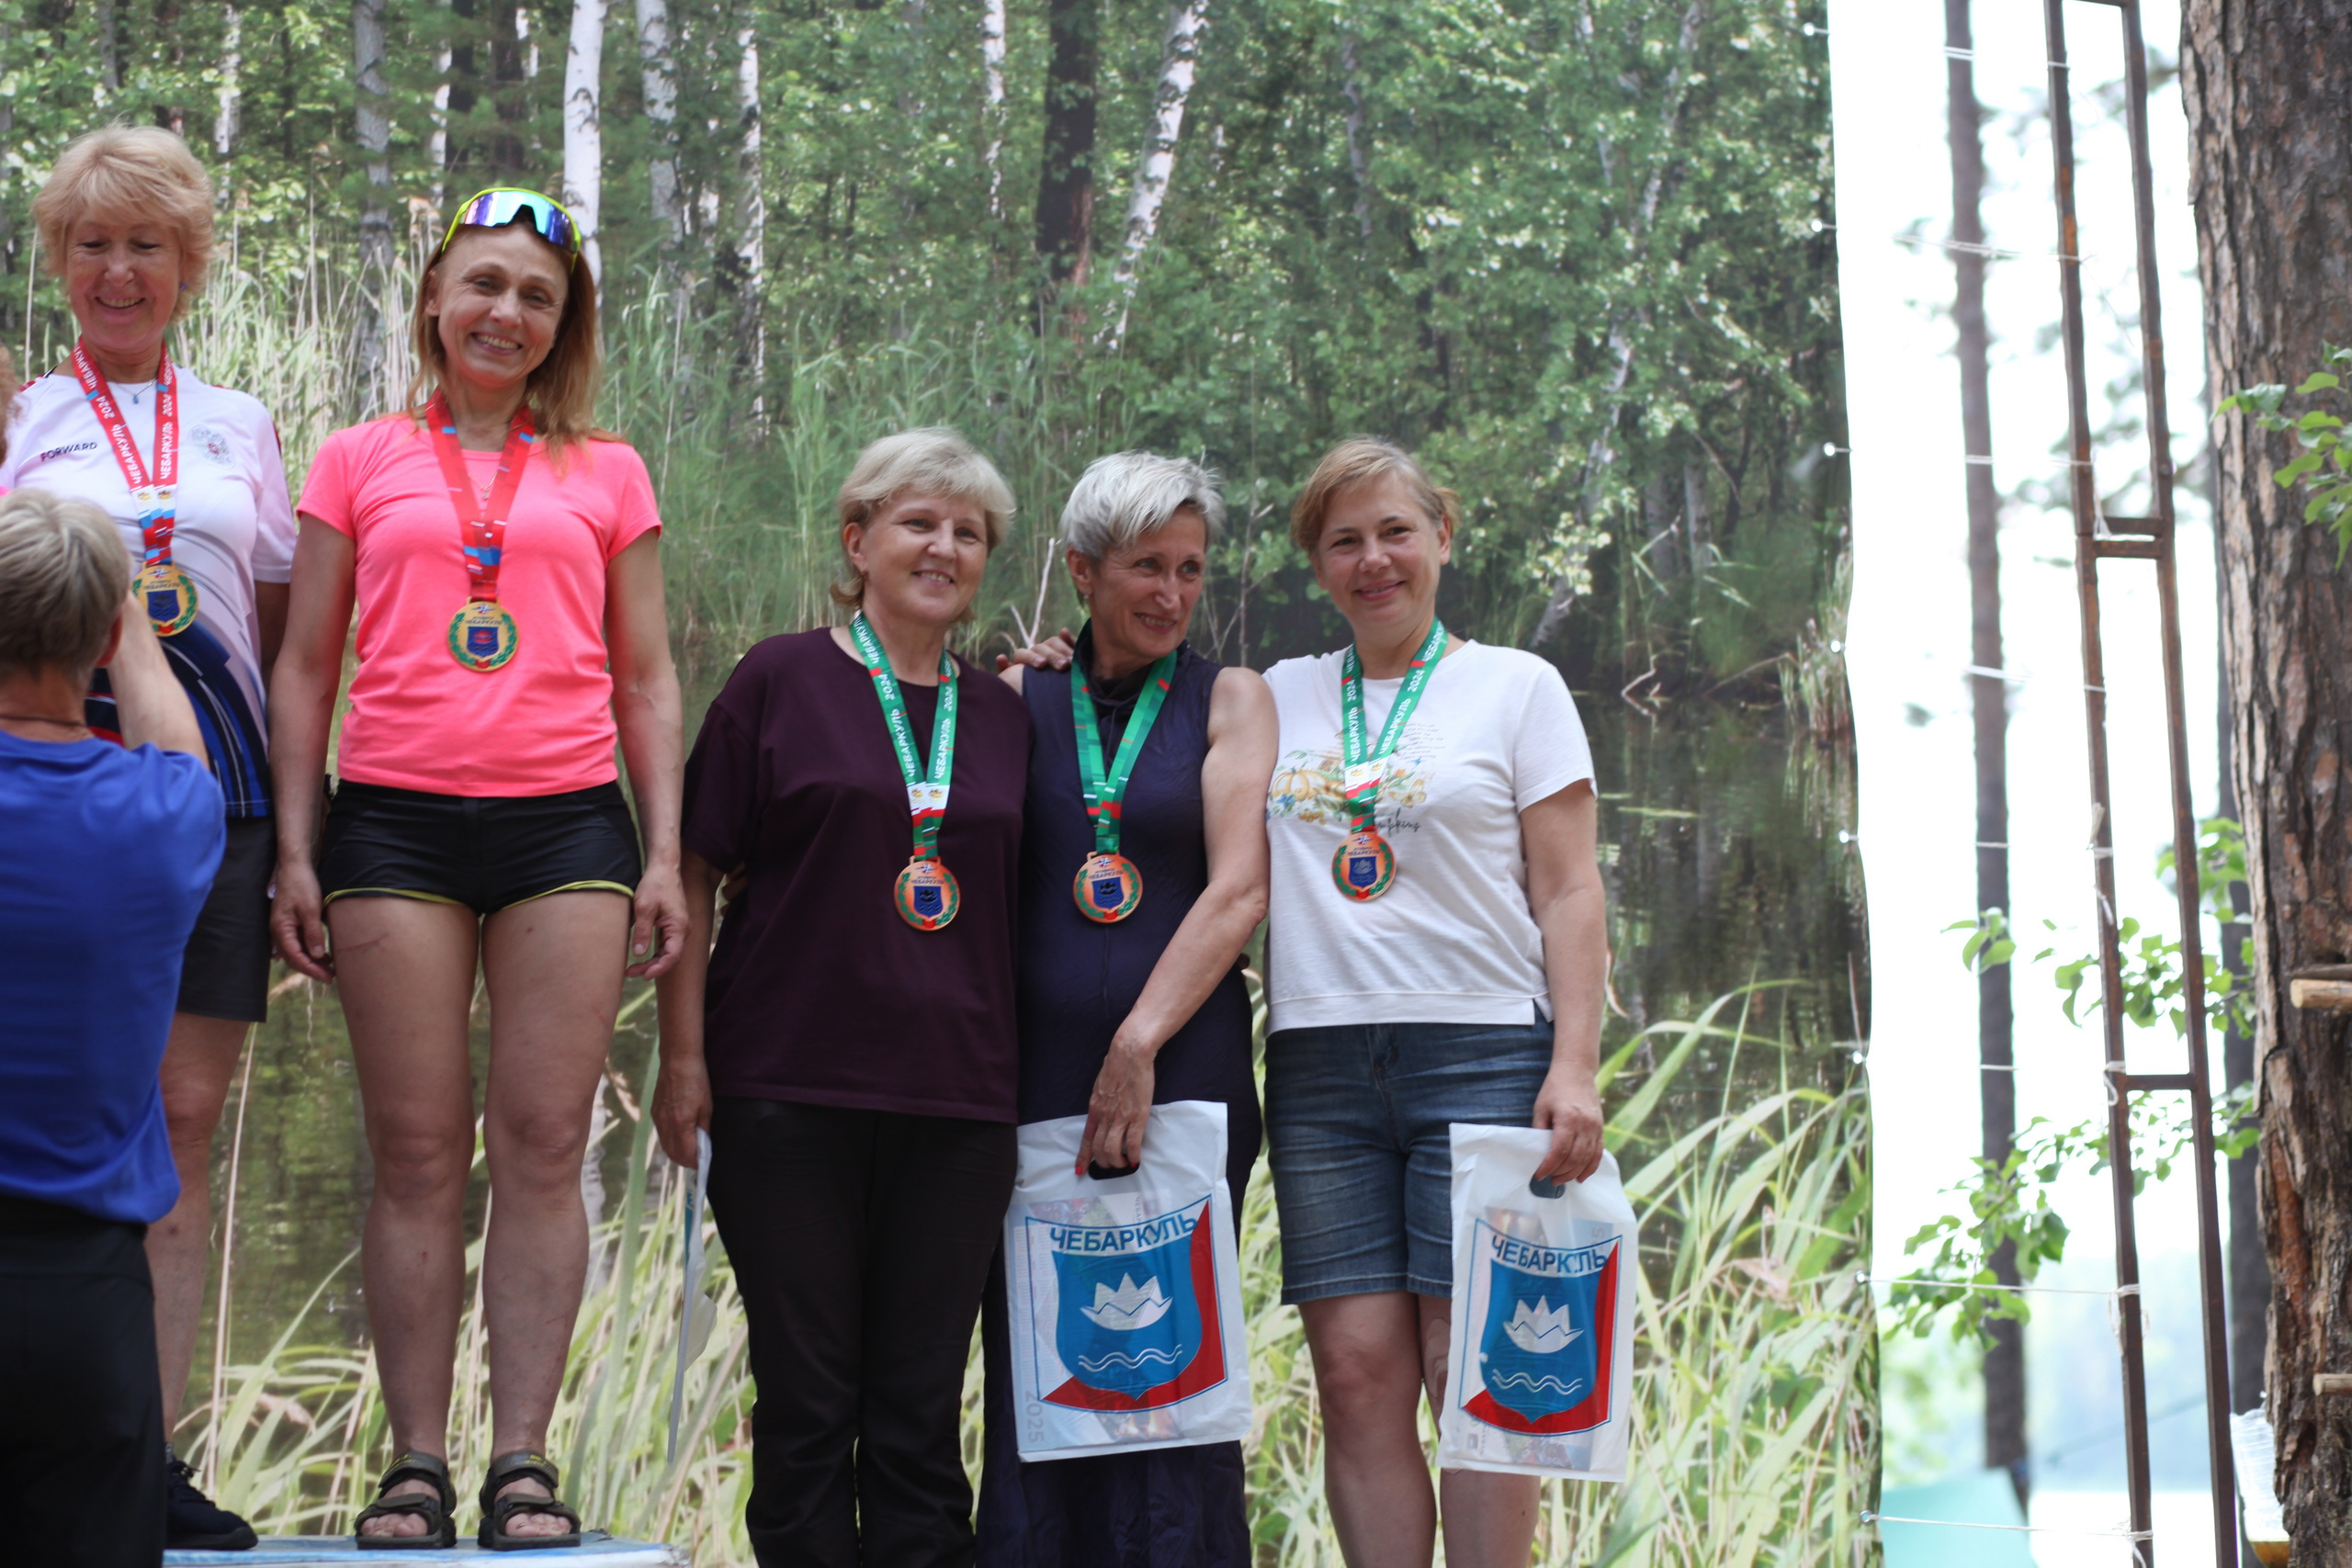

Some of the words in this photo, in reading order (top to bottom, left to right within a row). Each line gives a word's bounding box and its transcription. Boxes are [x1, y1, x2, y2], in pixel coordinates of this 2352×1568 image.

[96, 395, 115, 419] 2024
[163, 393, 173, 417] 2024
[40, 442, 97, 462] FORWARD
[111, 423, 143, 484] ЧЕБАРКУЛЬ
[160, 422, 173, 479] ЧЕБАРКУЛЬ
[878, 673, 896, 701] 2024
[1346, 679, 1357, 702] 2024
[1380, 697, 1412, 755] ЧЕБАРКУЛЬ
[1408, 669, 1425, 693] 2024
[890, 708, 916, 777] ЧЕБАРКУЛЬ
[934, 717, 951, 779] ЧЕБАРКУЛЬ
[944, 685, 954, 712] 2024
[1347, 706, 1361, 762] ЧЕБАРКУЛЬ
[1049, 1213, 1198, 1252] ЧЕБАРКУЛЬ
[1024, 1390, 1045, 1443] 2025
